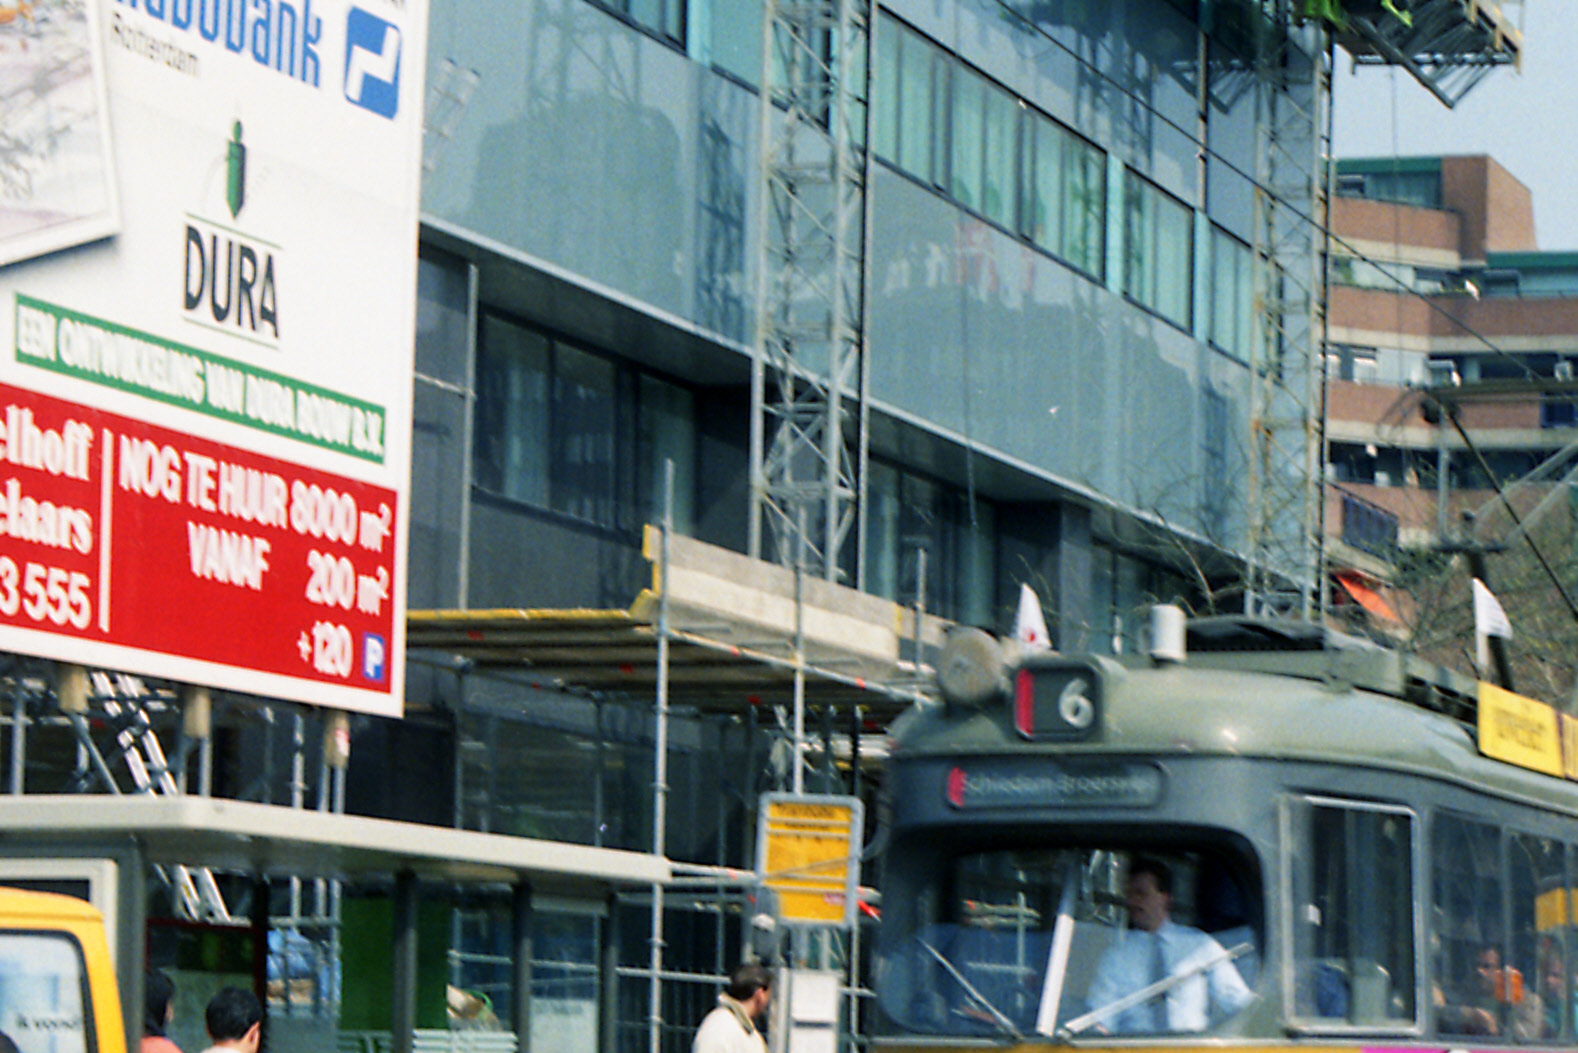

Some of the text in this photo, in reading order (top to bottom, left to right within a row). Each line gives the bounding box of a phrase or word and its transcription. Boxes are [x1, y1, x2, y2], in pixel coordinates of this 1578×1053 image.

[115, 0, 321, 88] obank
[184, 224, 279, 339] DURA
[17, 304, 56, 362] EEN
[206, 360, 245, 415] VAN
[246, 373, 295, 431] DURA
[297, 388, 351, 447] BOUW
[119, 434, 182, 504] NOG
[184, 450, 218, 514] TE
[218, 460, 288, 530] HUUR
[290, 479, 358, 546] 8000
[187, 519, 271, 591] VANAF
[305, 549, 356, 610] 200
[1059, 678, 1094, 729] 6
